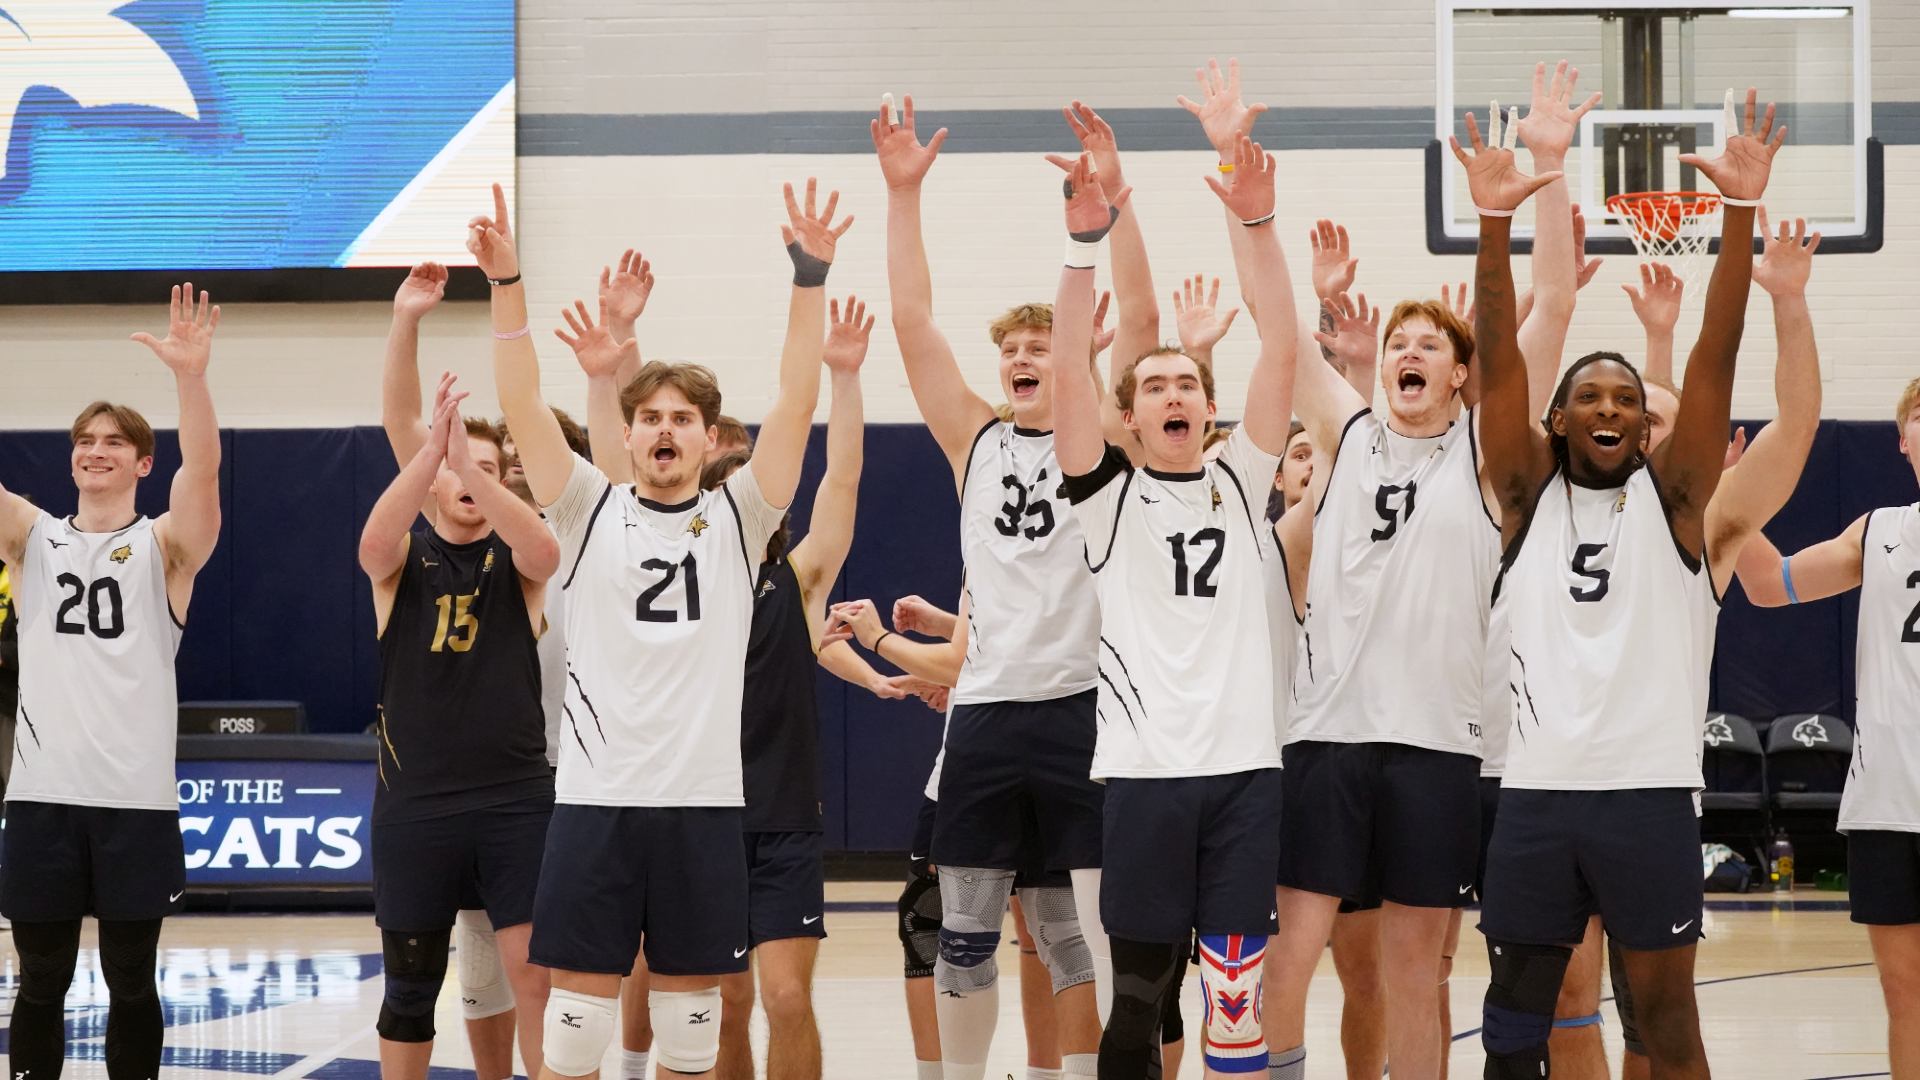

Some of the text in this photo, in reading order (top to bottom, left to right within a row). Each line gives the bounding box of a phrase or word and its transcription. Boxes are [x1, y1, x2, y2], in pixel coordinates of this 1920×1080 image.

[994, 467, 1055, 542] 35
[636, 551, 701, 622] 21
[1166, 528, 1225, 597] 12
[1569, 542, 1611, 602] 5
[56, 571, 125, 639] 20
[430, 587, 480, 653] 15
[219, 718, 255, 734] POSS
[176, 779, 284, 804] OF THE
